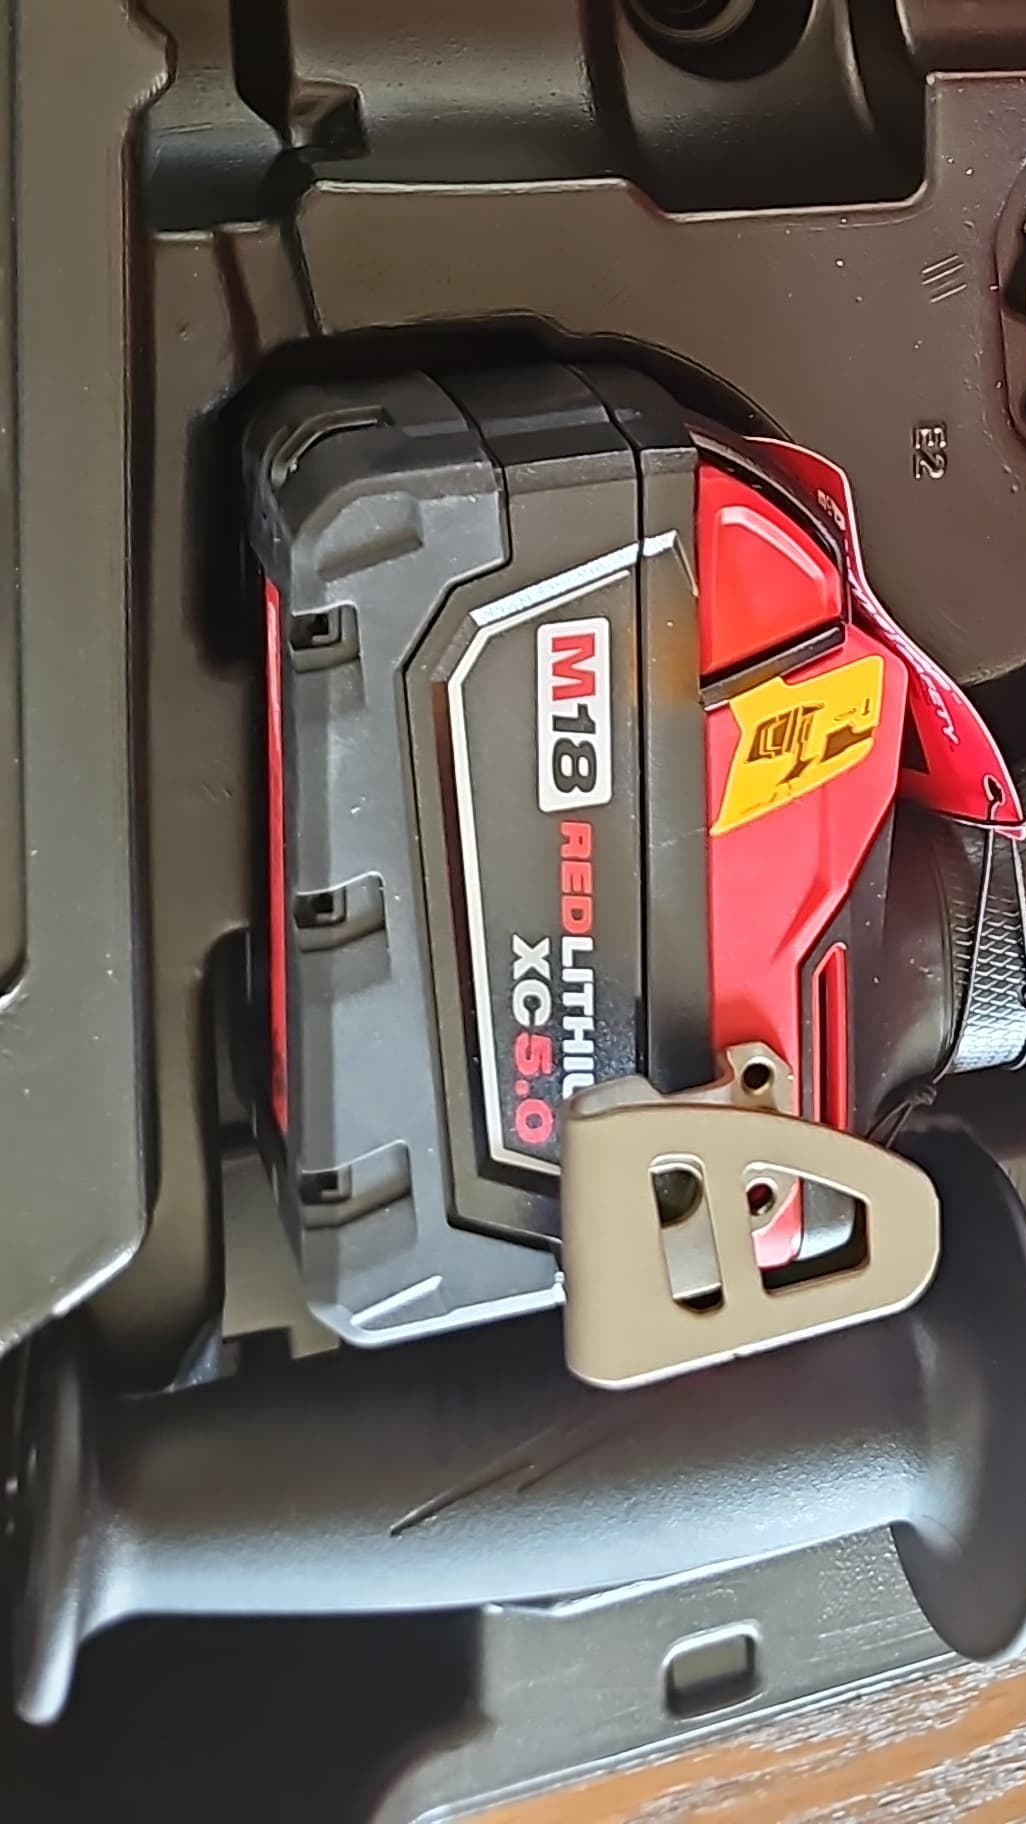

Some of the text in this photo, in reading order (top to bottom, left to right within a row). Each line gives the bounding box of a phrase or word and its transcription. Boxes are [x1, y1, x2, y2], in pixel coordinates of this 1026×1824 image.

[912, 421, 949, 481] E2
[546, 632, 600, 795] M18
[510, 932, 556, 1145] XC5.0
[557, 819, 596, 1100] REDLITHIU
